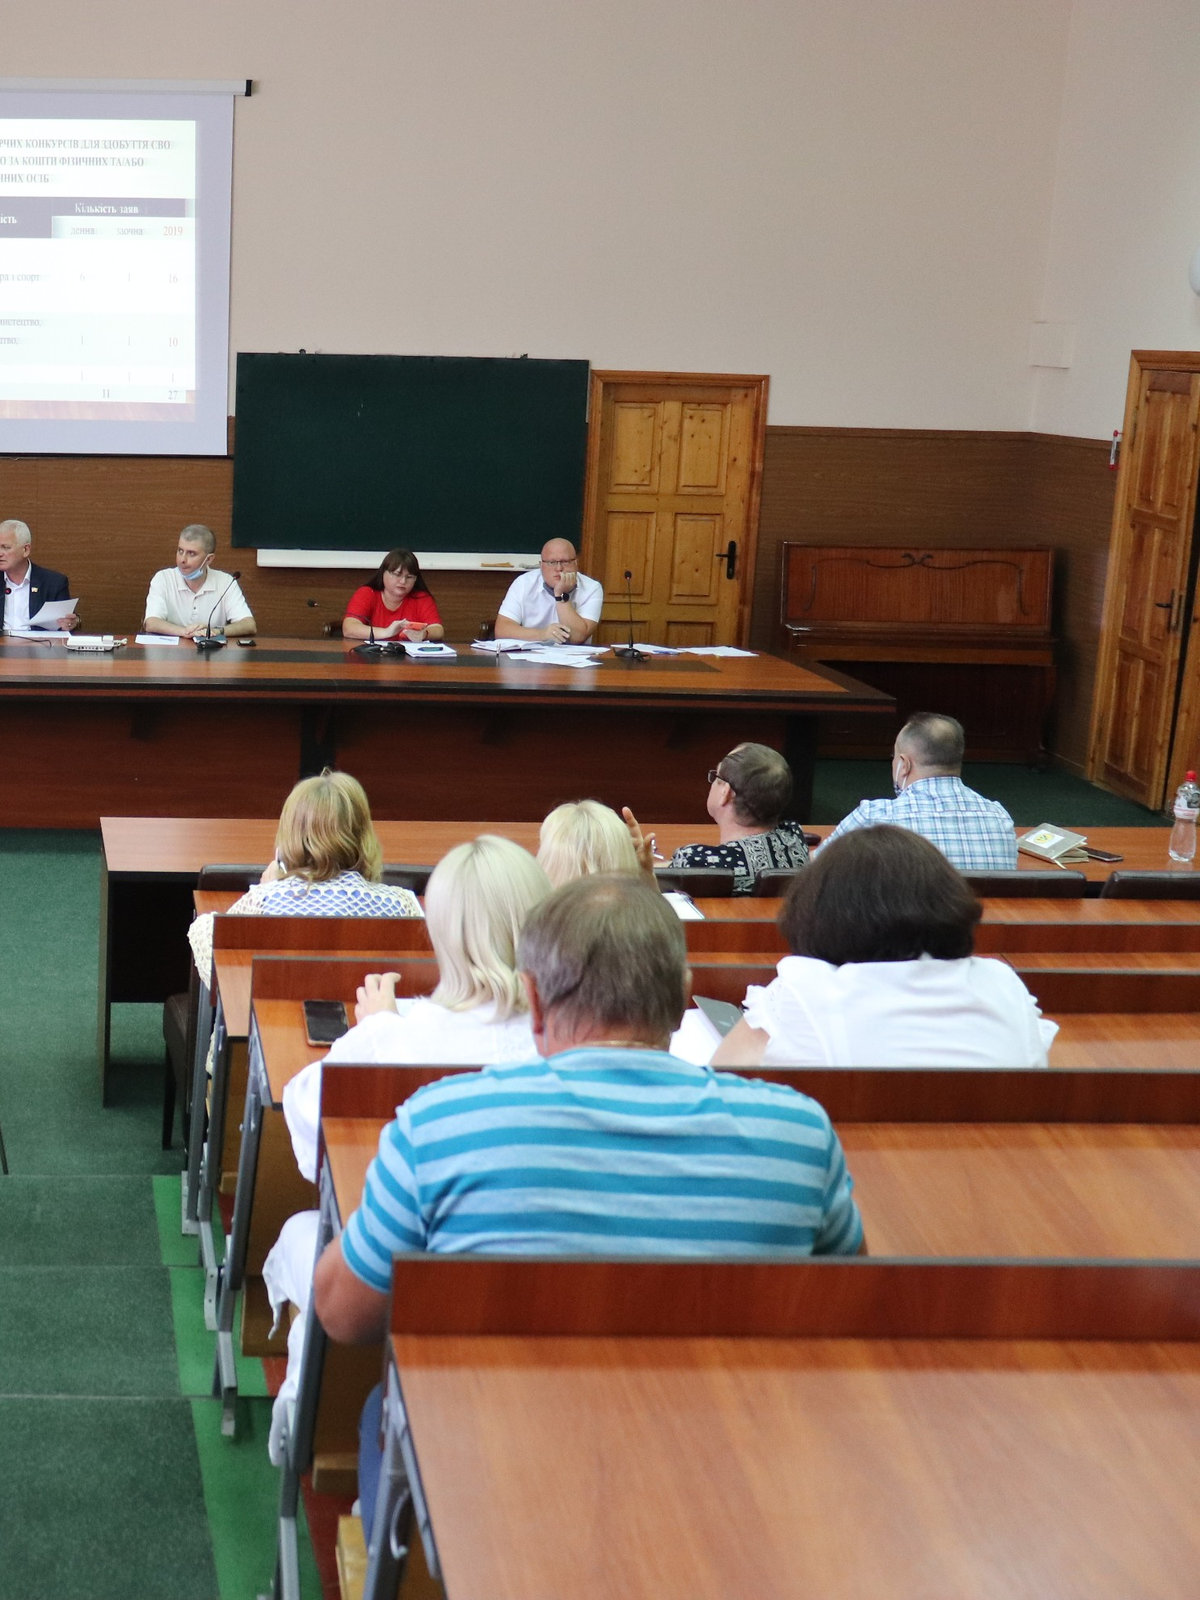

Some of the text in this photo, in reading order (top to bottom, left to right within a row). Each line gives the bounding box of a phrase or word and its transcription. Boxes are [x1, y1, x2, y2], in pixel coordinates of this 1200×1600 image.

[25, 138, 79, 149] КОНКУРСІВ
[101, 139, 149, 150] ЗДОБУТТЯ
[9, 156, 21, 166] ЗА
[22, 156, 57, 166] КОШТИ
[58, 156, 109, 167] ФІЗИЧНИХ
[26, 173, 50, 184] ОСІБ
[74, 202, 117, 214] Кількість
[162, 226, 184, 237] 2019
